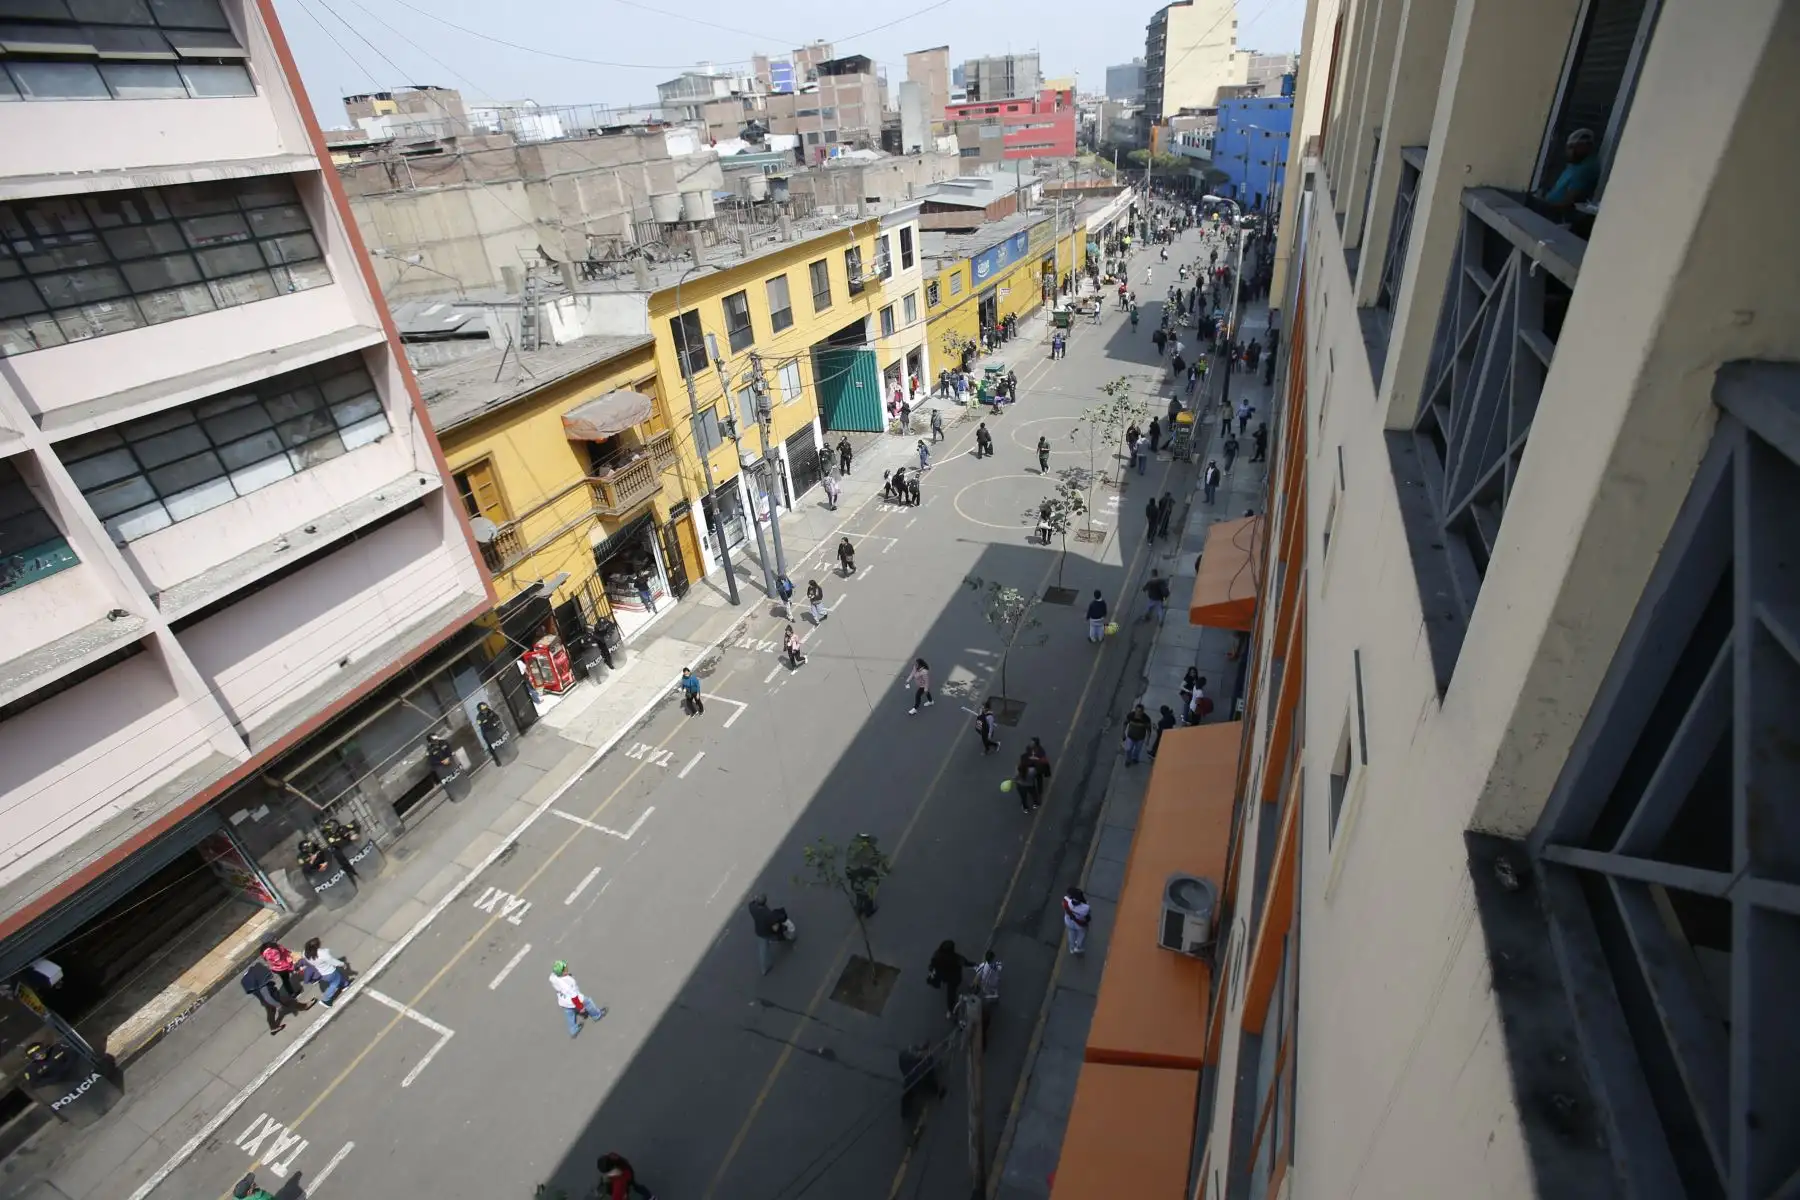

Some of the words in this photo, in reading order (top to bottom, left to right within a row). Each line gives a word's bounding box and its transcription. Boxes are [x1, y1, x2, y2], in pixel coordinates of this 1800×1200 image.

[624, 742, 674, 767] TAXI
[472, 886, 532, 926] TAXI
[51, 1072, 102, 1111] POLICIA
[234, 1112, 309, 1178] TAXI
